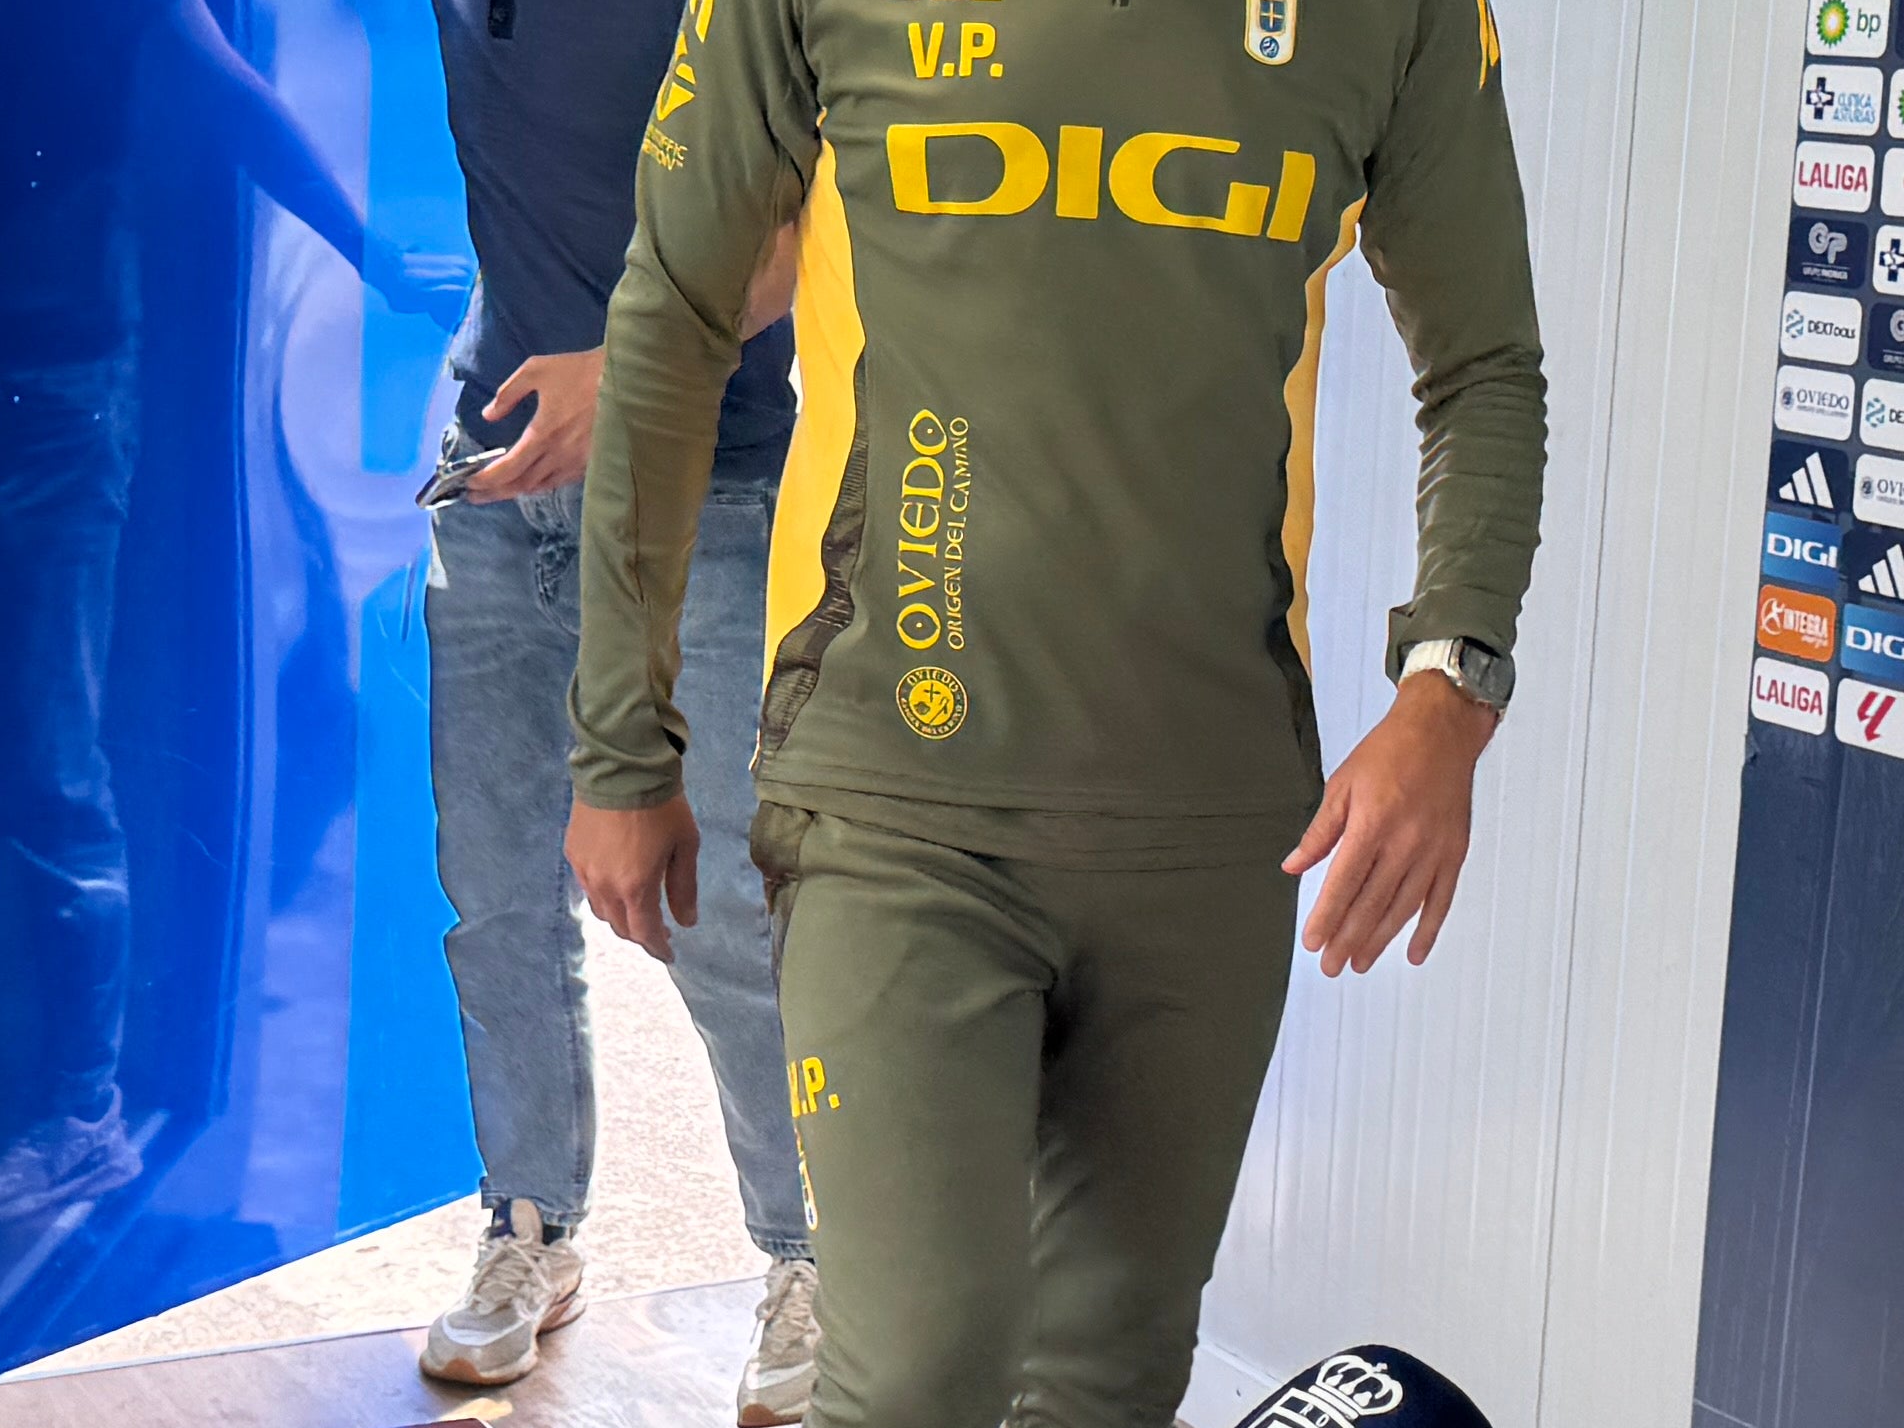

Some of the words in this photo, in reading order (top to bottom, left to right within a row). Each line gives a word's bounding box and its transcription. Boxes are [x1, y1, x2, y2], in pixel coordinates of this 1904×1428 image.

[907, 22, 1004, 79] V.P.
[886, 121, 1317, 242] DIGI
[1797, 160, 1868, 192] LALIGA
[948, 416, 972, 514] CAMINO
[896, 408, 949, 651] OVIEDO
[944, 515, 968, 562] DEL
[1766, 532, 1837, 568] DIGI
[944, 567, 967, 651] ORIGEN
